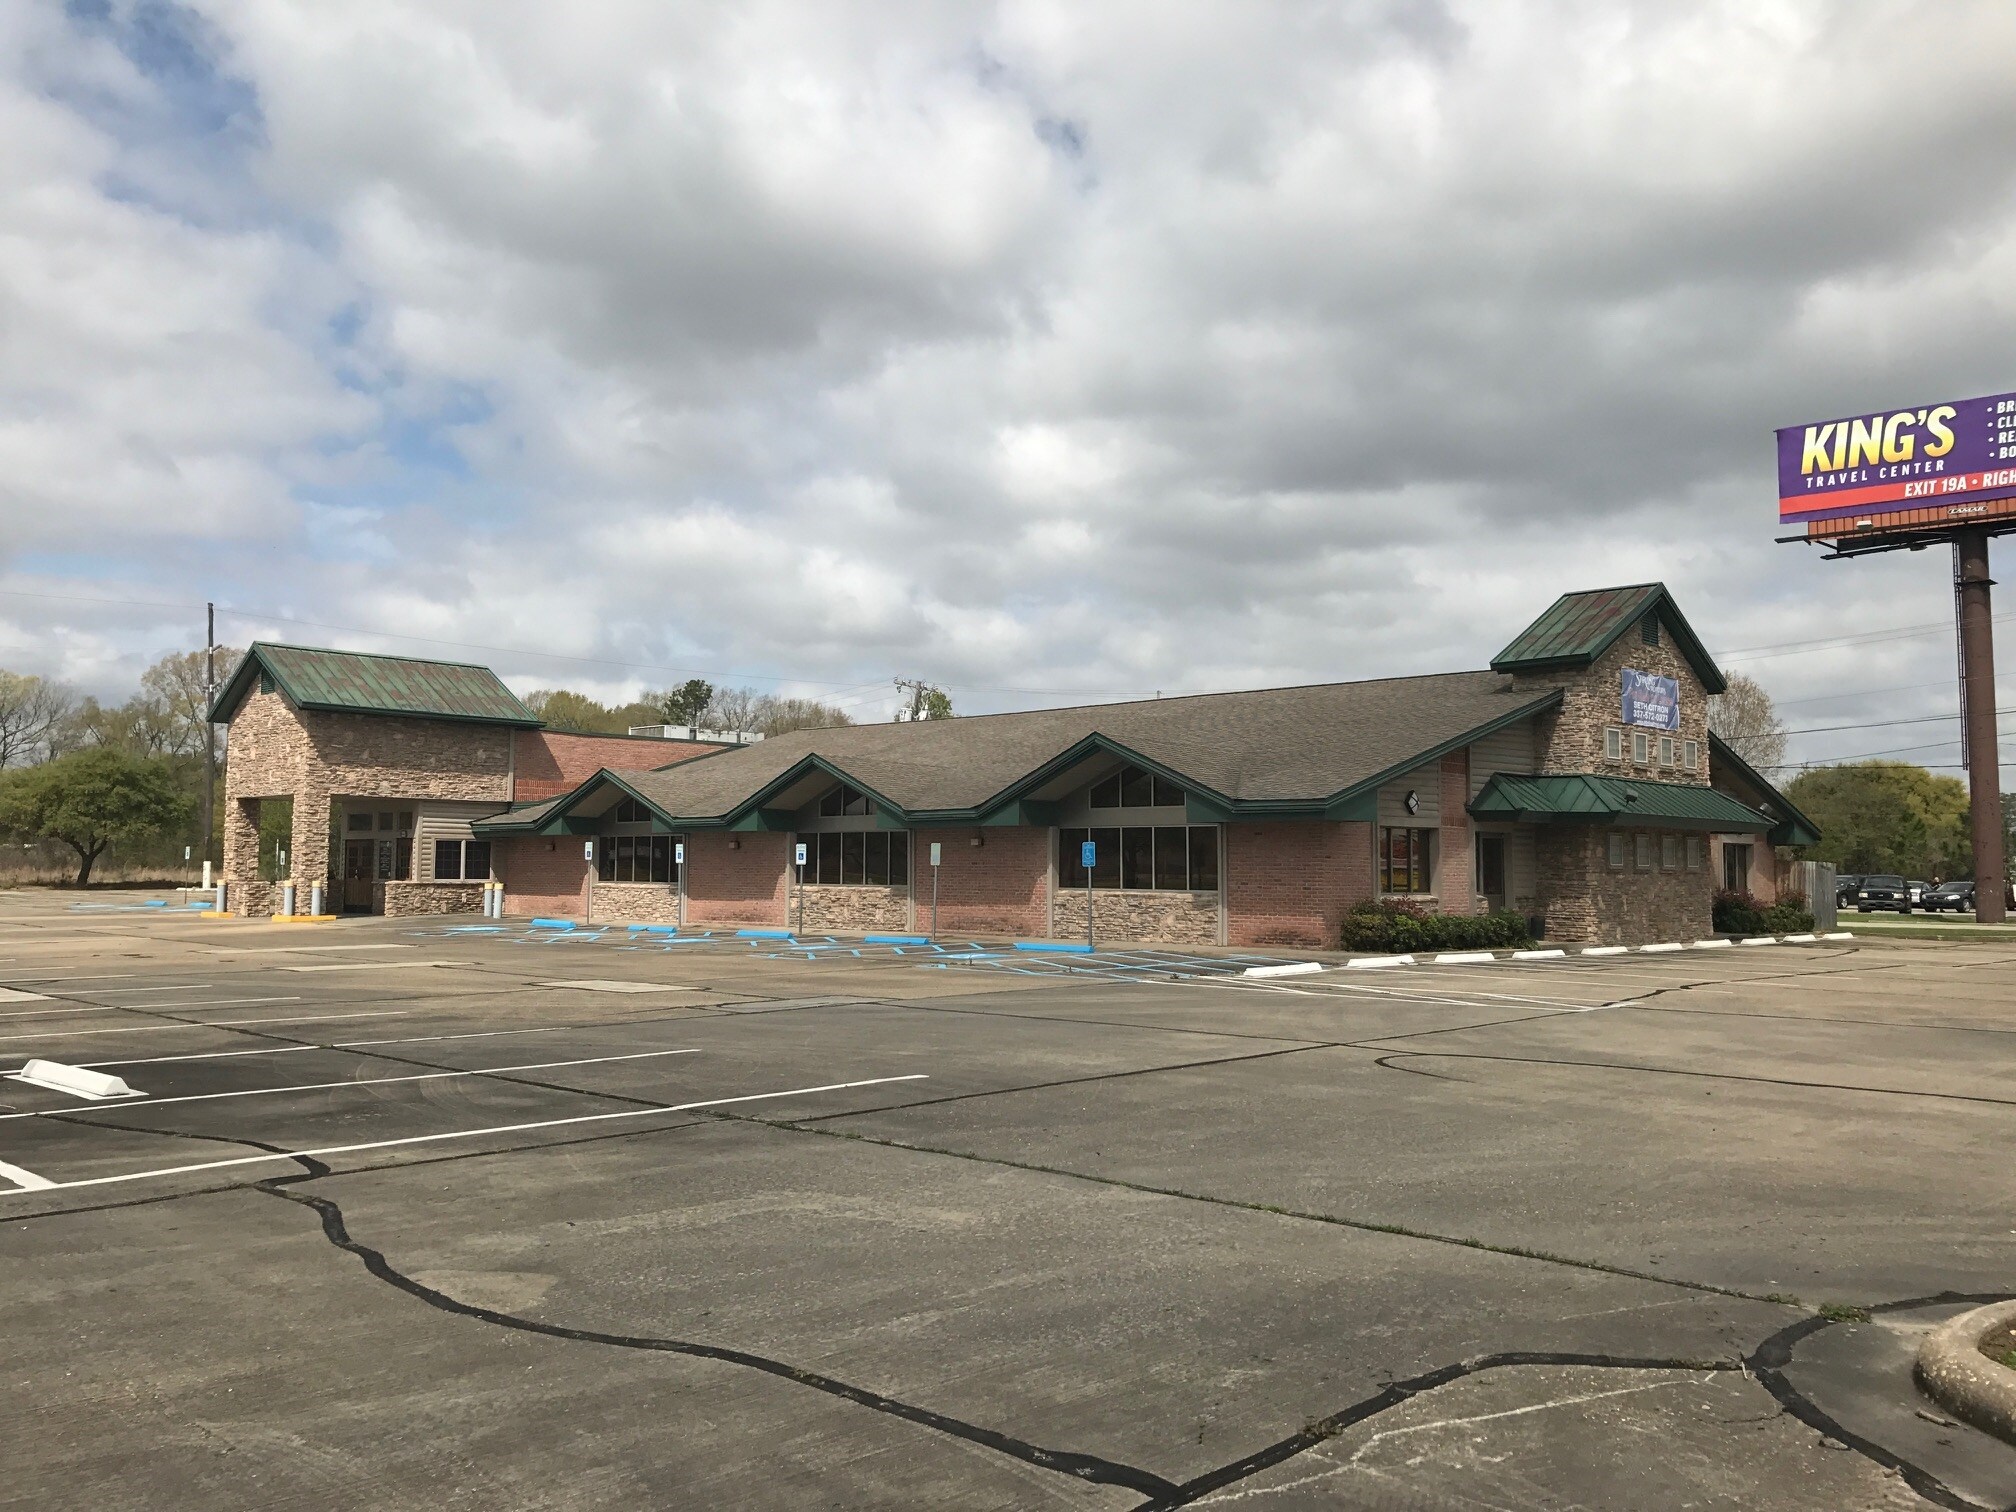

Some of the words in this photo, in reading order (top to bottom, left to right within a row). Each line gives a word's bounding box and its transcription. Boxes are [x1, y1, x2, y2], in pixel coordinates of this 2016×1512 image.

[1997, 400, 2016, 414] BR
[1801, 405, 1957, 475] KING'S
[1998, 430, 2016, 444] RE
[1806, 470, 1868, 489] TRAVEL
[1879, 459, 1945, 479] CENTER
[1904, 479, 1937, 498] EXIT
[1941, 476, 1967, 493] 19A
